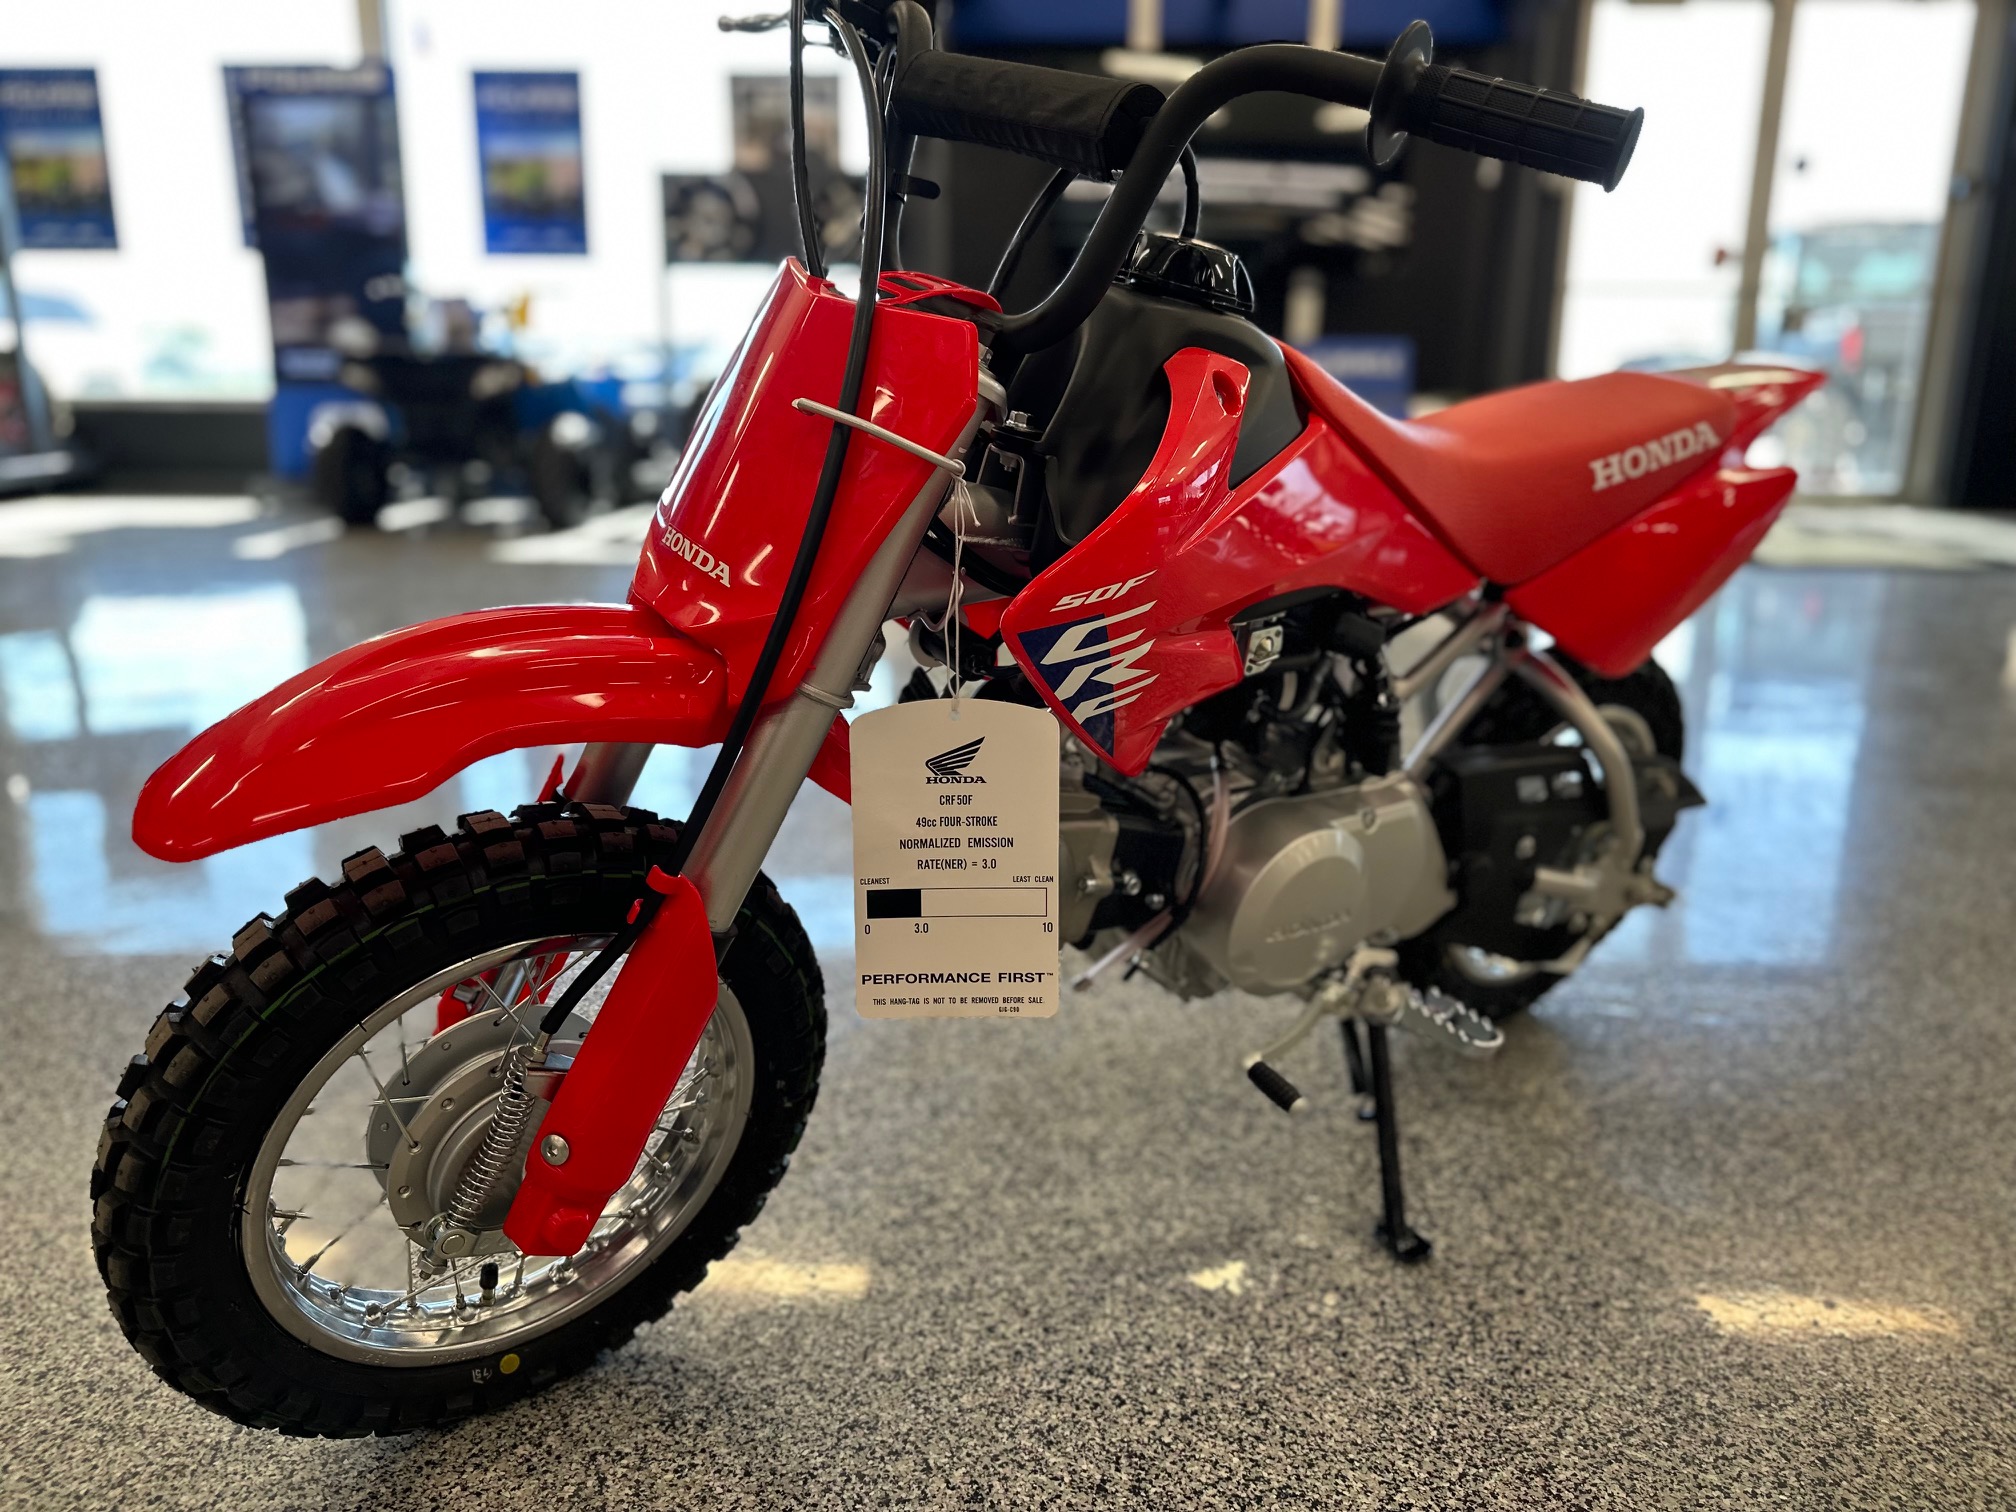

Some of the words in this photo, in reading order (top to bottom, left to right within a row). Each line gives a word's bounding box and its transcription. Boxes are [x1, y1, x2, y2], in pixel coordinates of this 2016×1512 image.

[1588, 420, 1722, 493] HONDA
[661, 525, 731, 588] HONDA
[1049, 569, 1158, 613] 50F
[925, 776, 987, 785] HONDA
[916, 816, 937, 828] 49cc
[939, 815, 998, 827] FOUR-STROKE
[899, 837, 961, 850] NORMALIZED
[967, 836, 1014, 849] EMISSION
[917, 857, 967, 871] RATE(NER)
[981, 858, 997, 870] 3.0
[859, 877, 890, 886] CLEANEST
[1012, 875, 1032, 883] LEAST
[1034, 875, 1054, 883] CLEAN
[864, 923, 871, 935] 0
[914, 922, 929, 934] 3.0
[1042, 921, 1053, 933] 10
[861, 972, 992, 985] PERFORMANCE
[872, 997, 887, 1006] THIS
[889, 997, 920, 1005] HANG-TAG
[923, 997, 930, 1005] IS
[932, 997, 945, 1005] NOT
[960, 996, 968, 1004] BE
[971, 996, 999, 1004] REMOVED
[1002, 996, 1025, 1004] BEFORE
